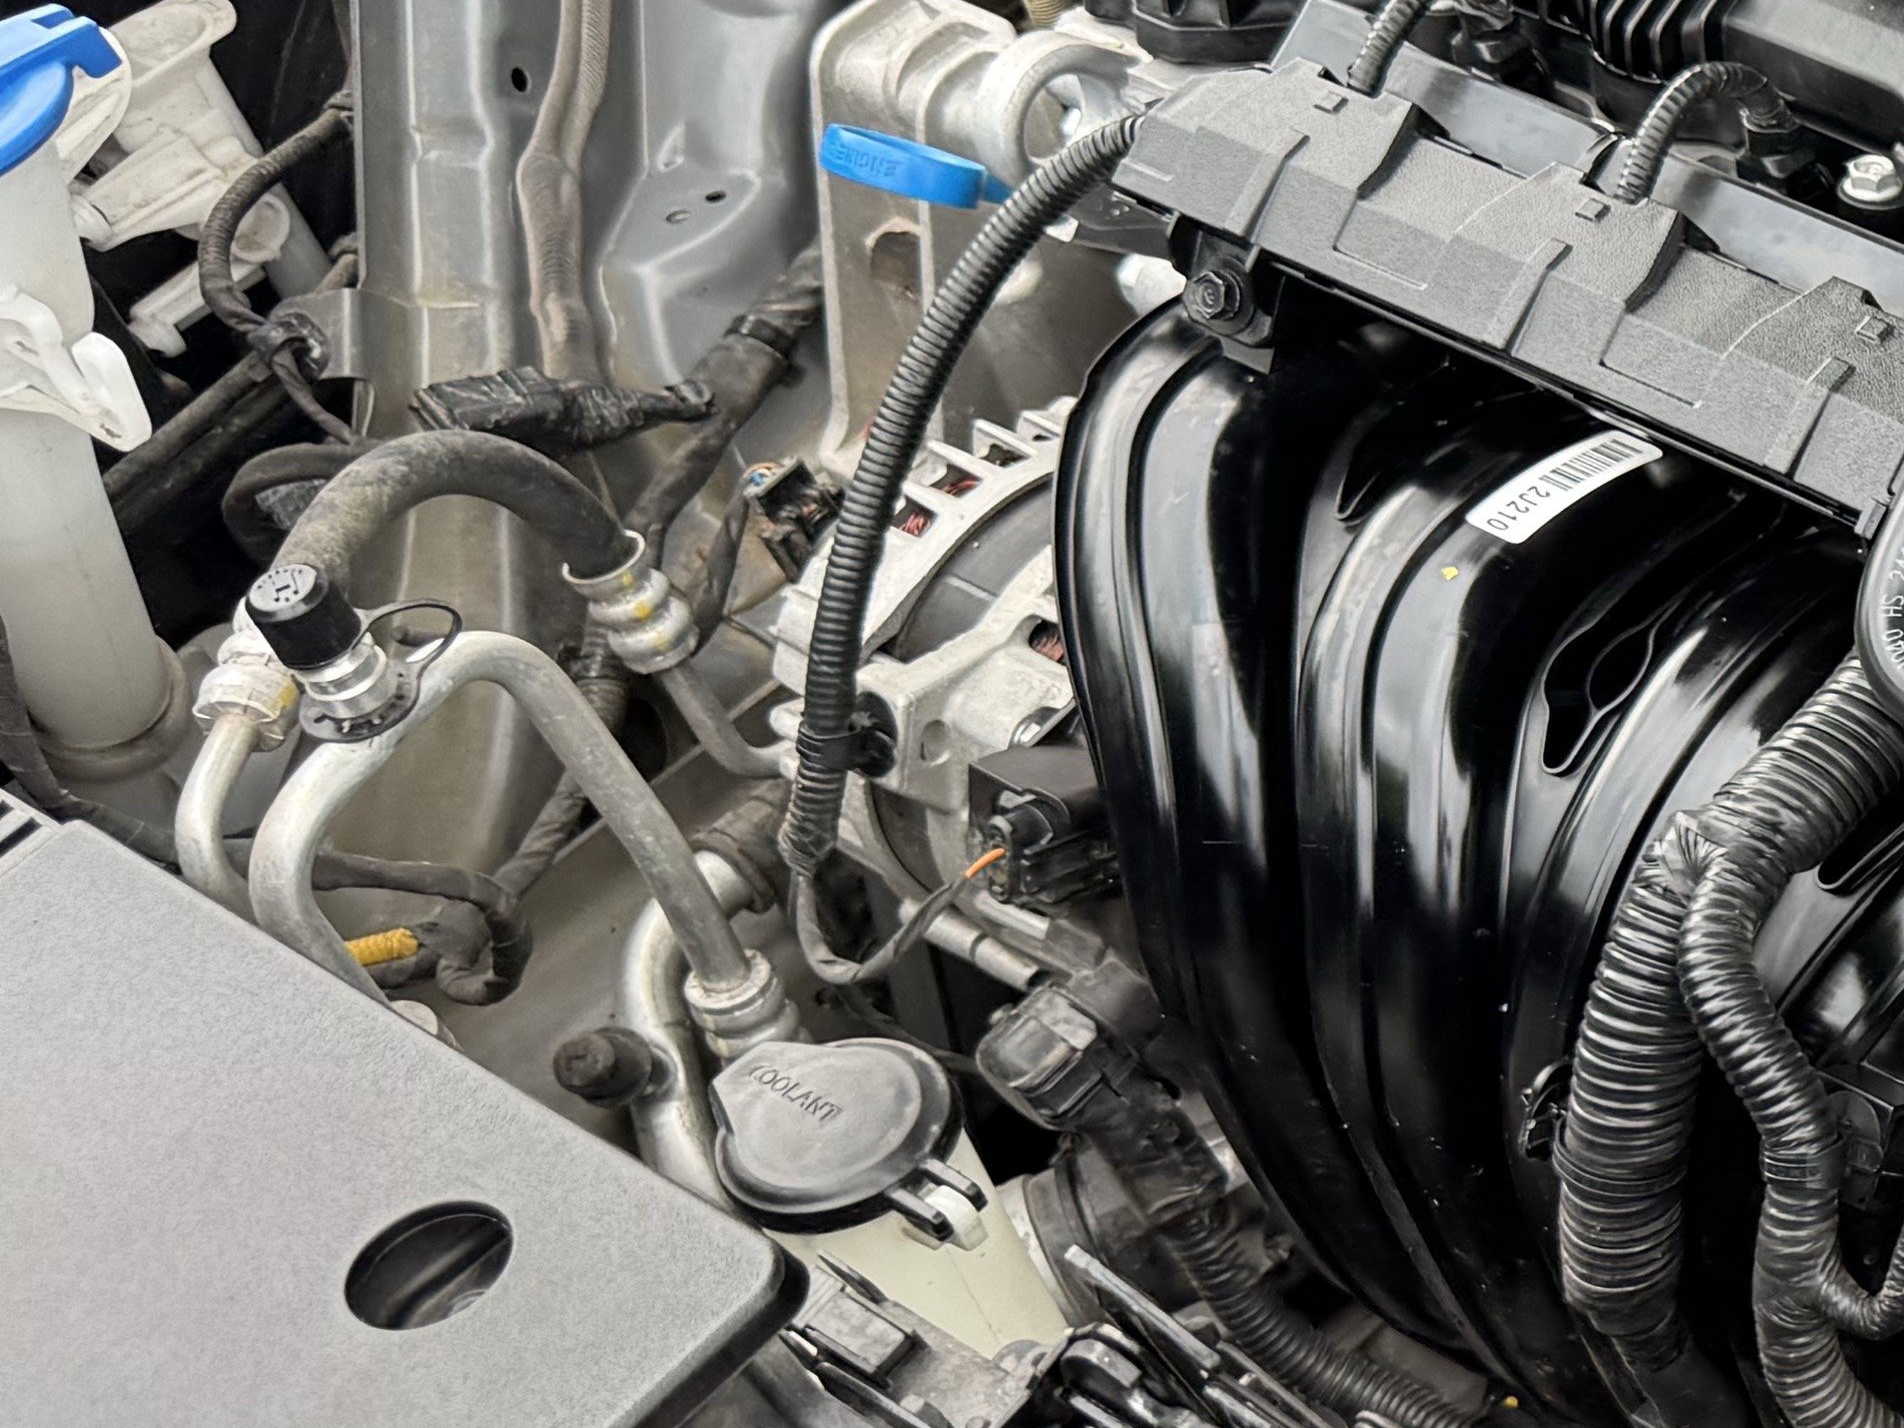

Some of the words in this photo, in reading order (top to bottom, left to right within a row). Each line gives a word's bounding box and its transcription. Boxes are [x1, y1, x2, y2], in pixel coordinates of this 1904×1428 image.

[1486, 484, 1551, 532] 2J210
[1880, 593, 1904, 622] HS
[749, 1064, 843, 1123] COOLANT
